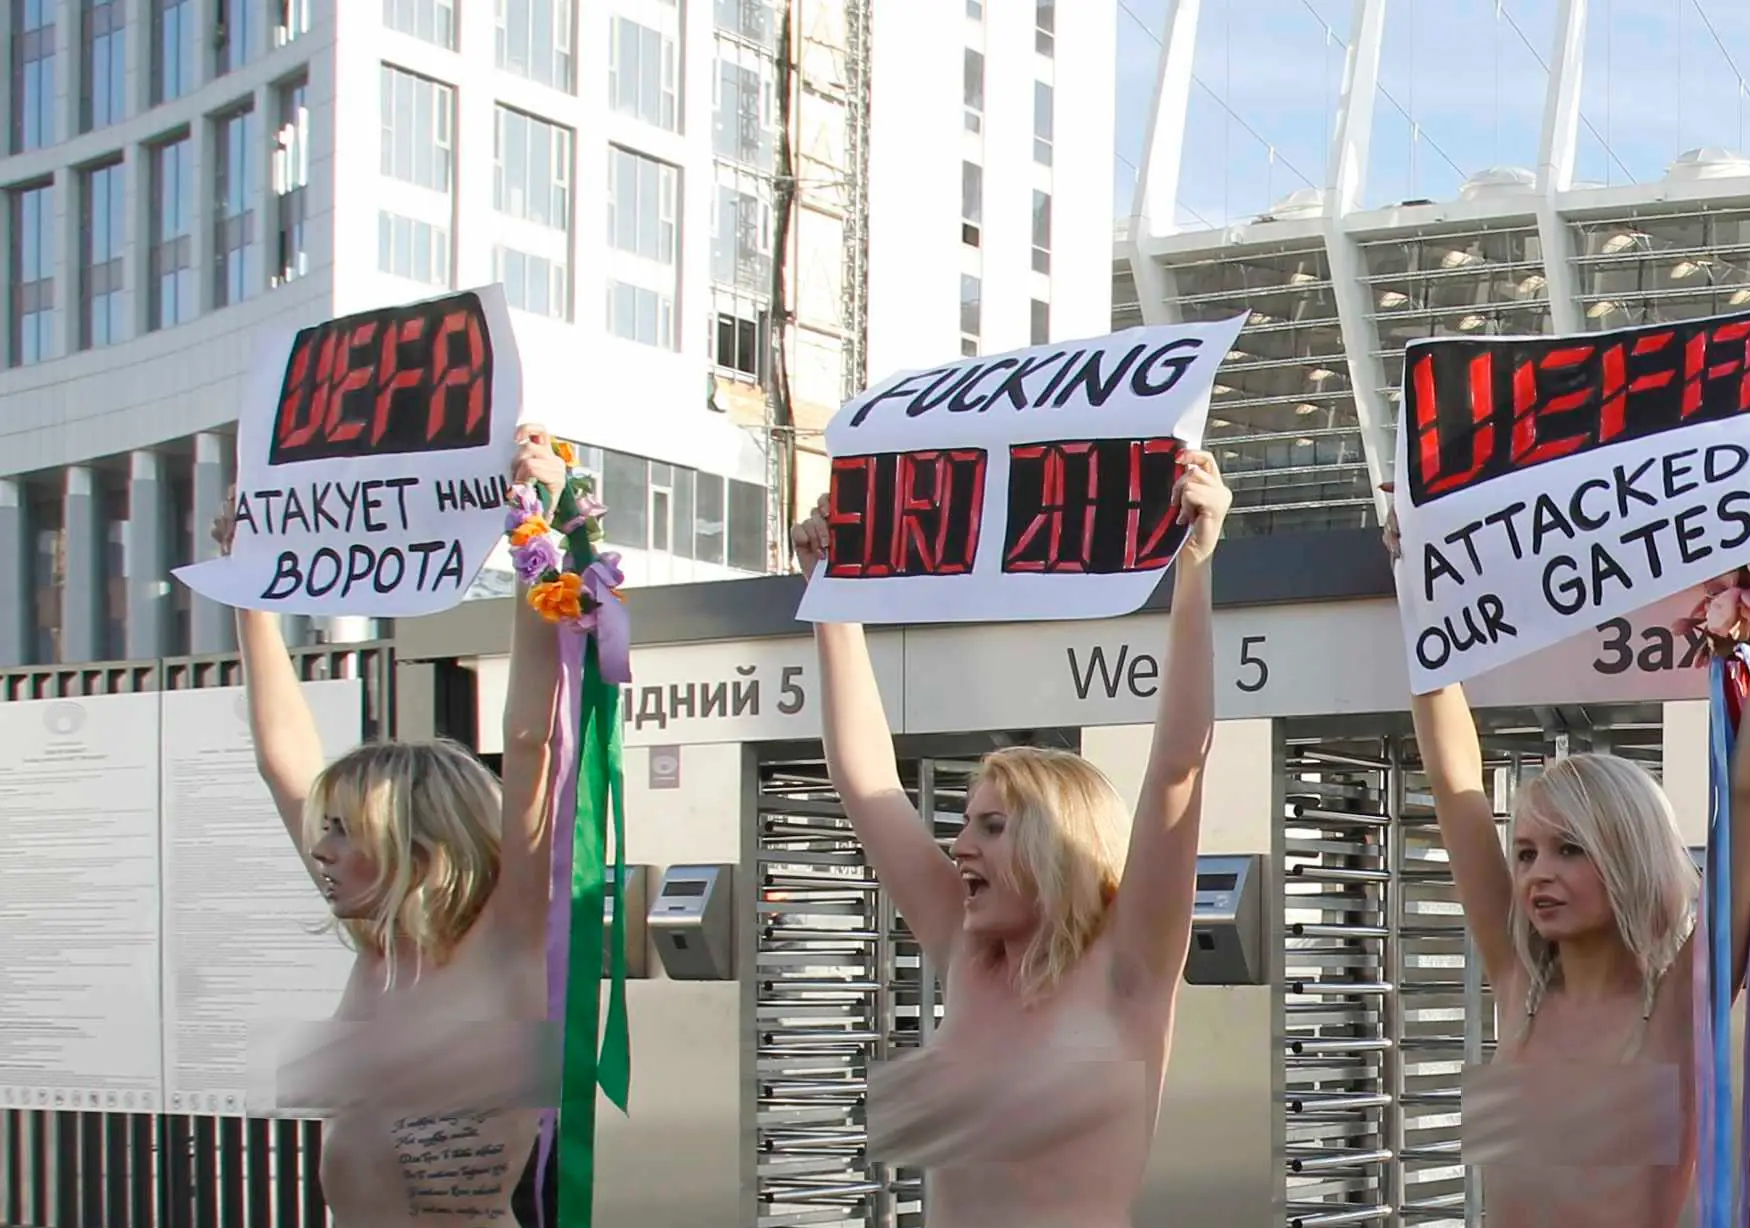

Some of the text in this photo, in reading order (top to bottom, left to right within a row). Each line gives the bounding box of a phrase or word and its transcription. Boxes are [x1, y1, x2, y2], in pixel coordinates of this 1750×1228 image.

[279, 309, 484, 450] UEFA
[849, 338, 1204, 427] FUCKING
[234, 477, 419, 535] АТАКУЕТ
[1423, 443, 1749, 601] ATTACKED
[260, 539, 465, 600] ВОРОТА
[1415, 593, 1517, 670] OUR
[776, 666, 805, 715] 5
[1067, 636, 1269, 699] We 5
